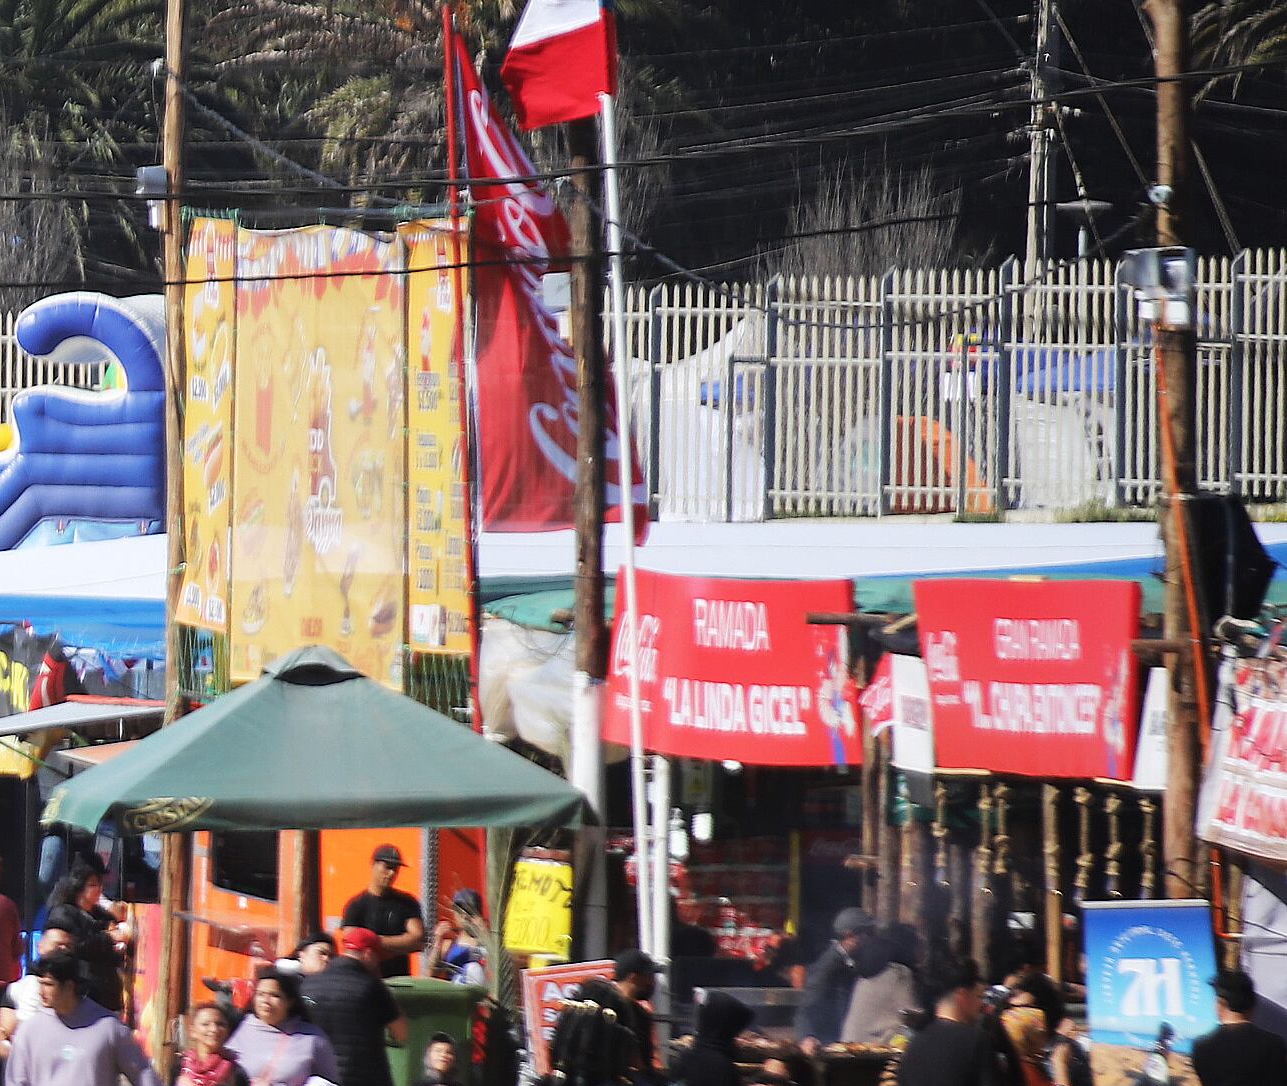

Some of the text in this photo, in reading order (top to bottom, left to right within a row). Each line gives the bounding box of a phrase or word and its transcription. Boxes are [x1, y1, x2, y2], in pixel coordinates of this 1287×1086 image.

[693, 597, 770, 651] RAMADA
[1029, 619, 1081, 661] RAMADA
[693, 680, 748, 734] LINDA
